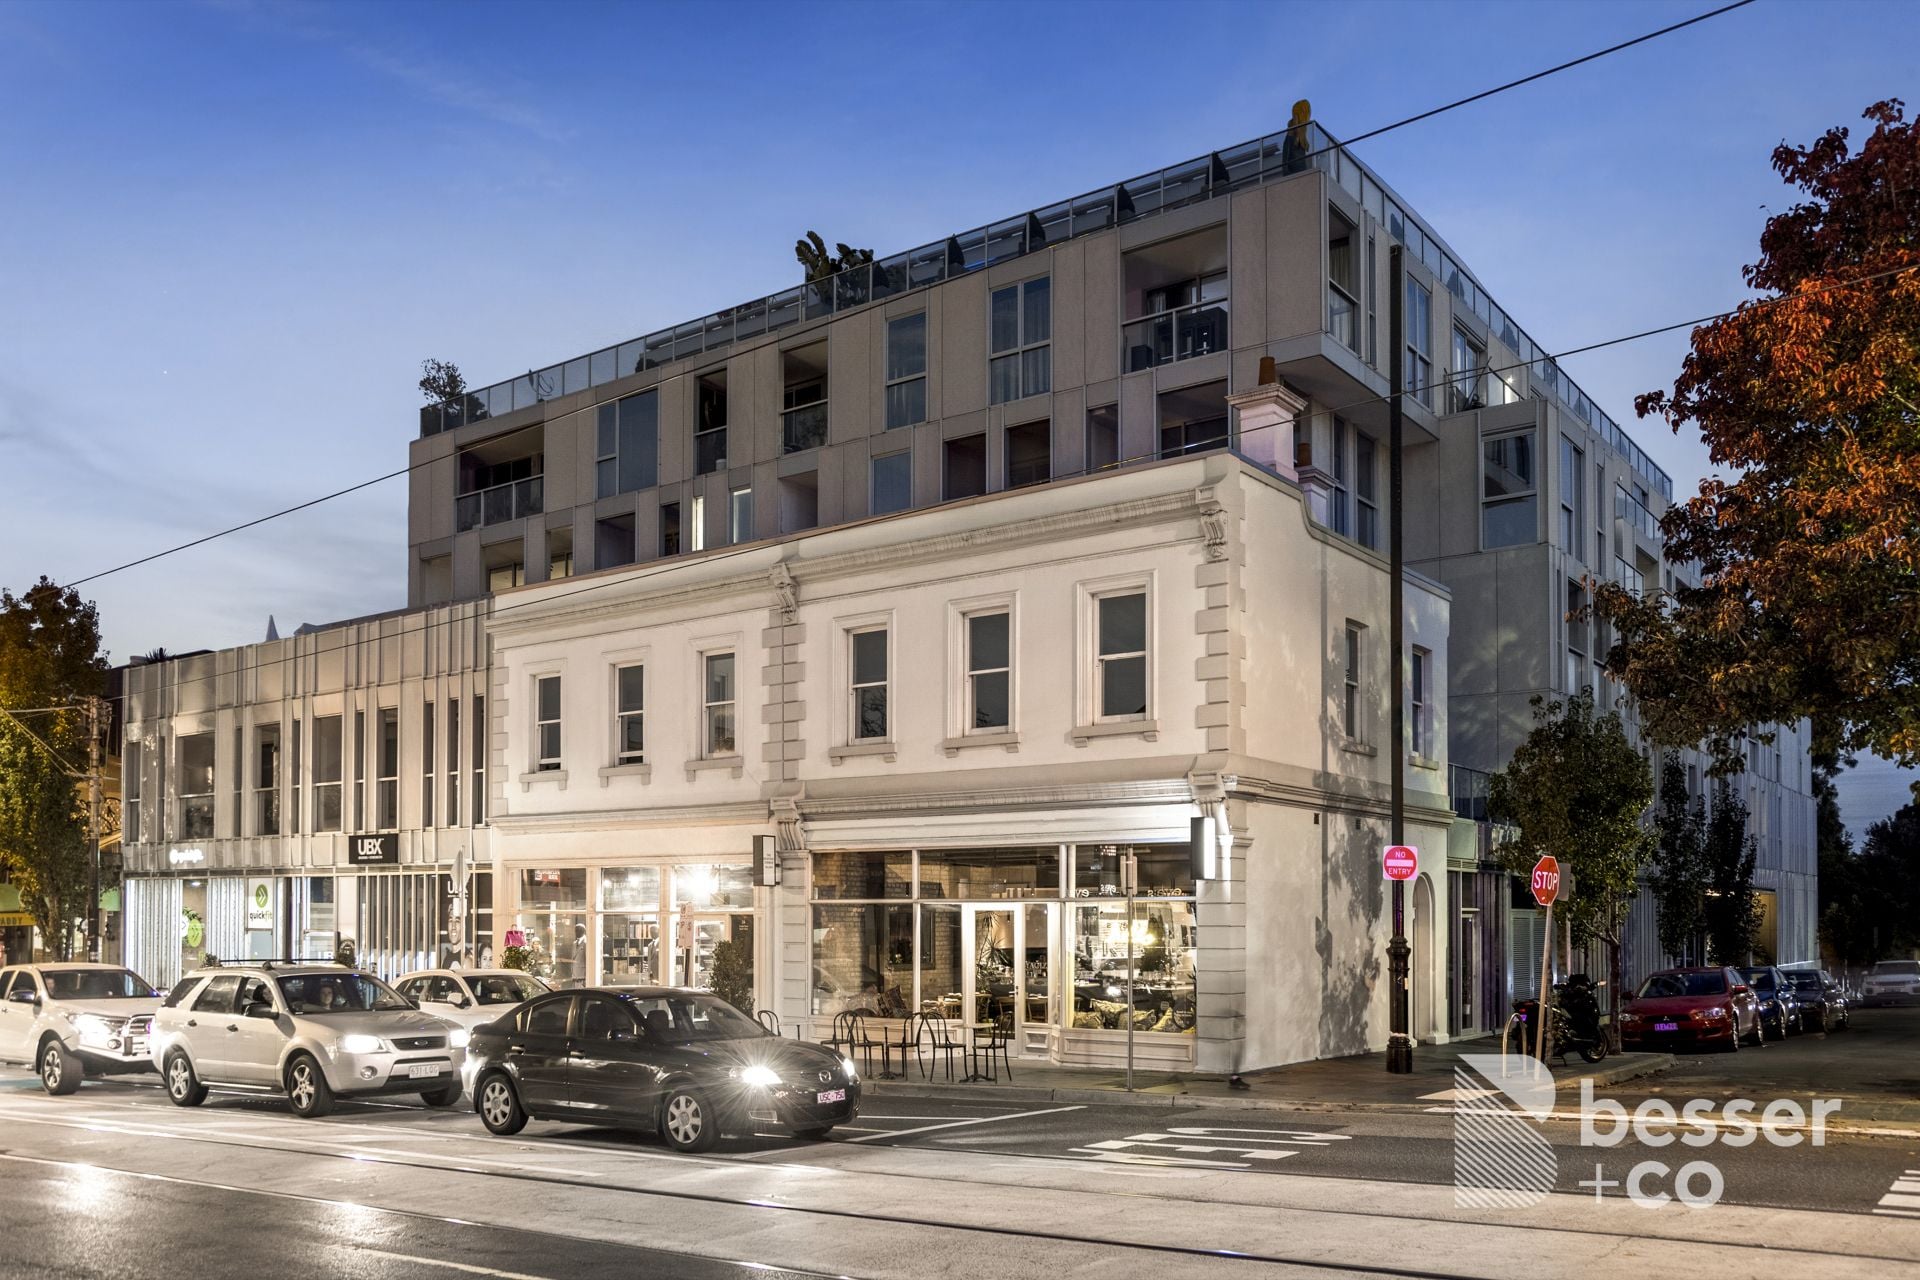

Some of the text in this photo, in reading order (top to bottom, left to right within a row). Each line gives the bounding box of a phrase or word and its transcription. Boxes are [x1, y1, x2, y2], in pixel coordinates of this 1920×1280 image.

[358, 838, 383, 855] UBX
[1388, 867, 1412, 875] ENTRY
[1533, 871, 1558, 890] STOP
[0, 917, 23, 926] ADDY
